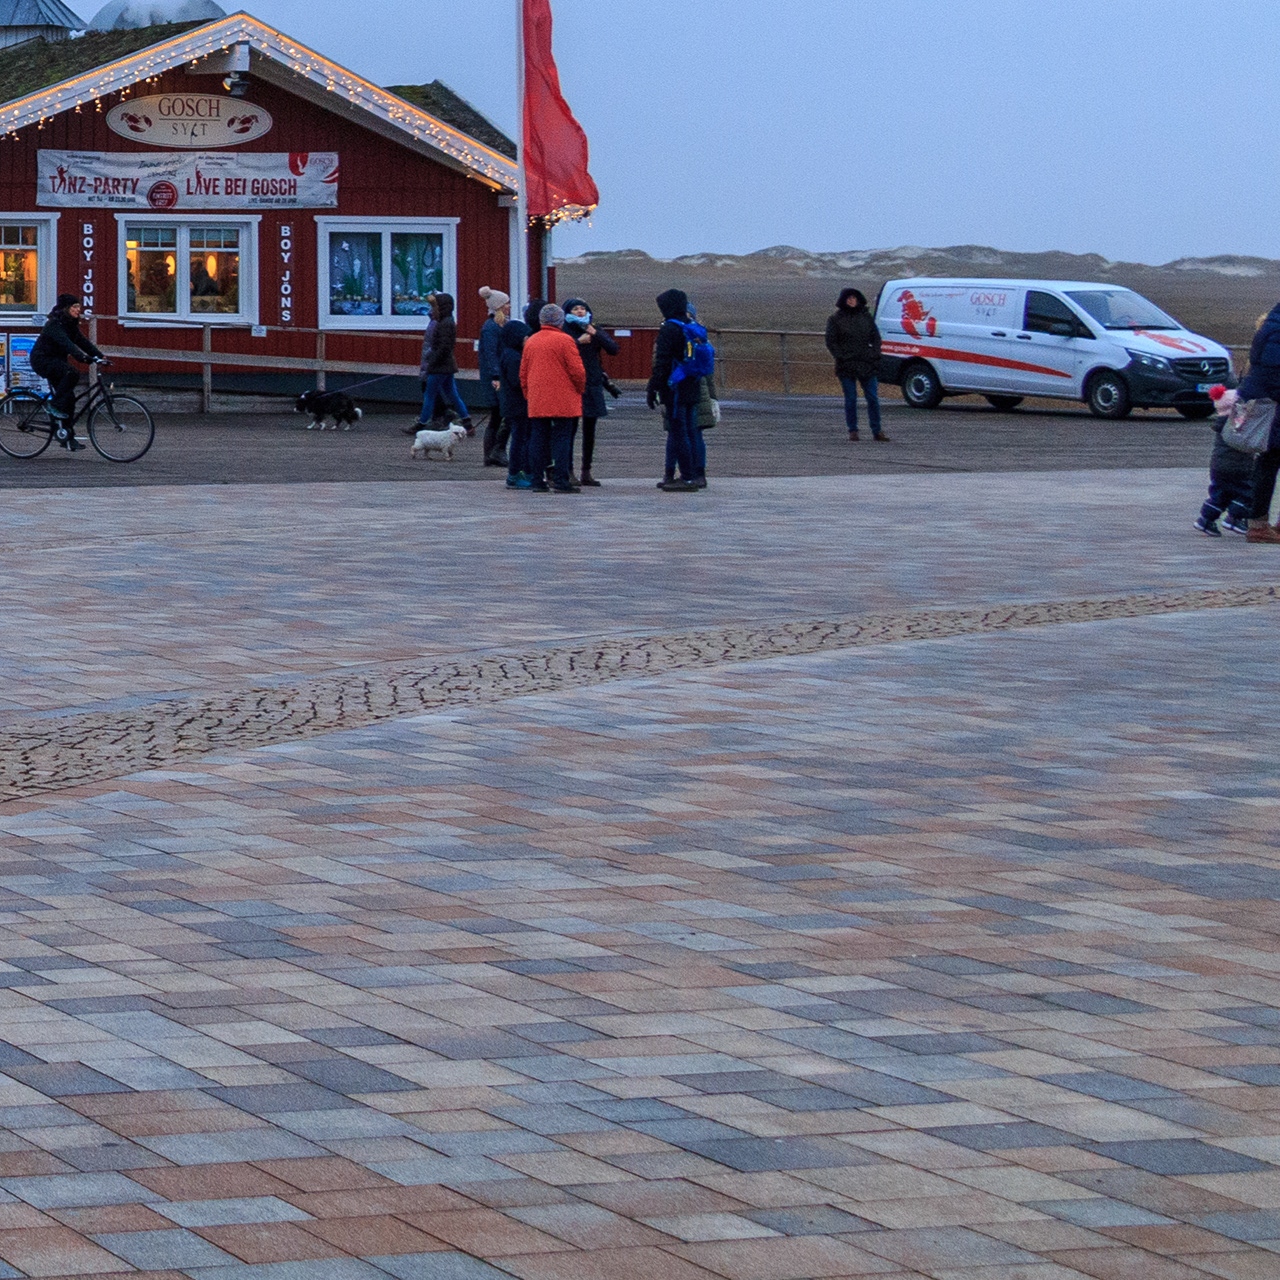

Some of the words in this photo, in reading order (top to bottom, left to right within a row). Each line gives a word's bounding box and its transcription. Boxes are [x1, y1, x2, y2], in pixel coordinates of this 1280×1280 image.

[158, 97, 221, 118] GOSCH
[171, 122, 209, 138] SYLT
[224, 178, 247, 196] BEI
[251, 178, 297, 196] GOSCH
[82, 223, 94, 261] BOY
[280, 225, 292, 263] BOY
[280, 270, 292, 321] JÖNS
[970, 291, 1007, 306] GOSCH
